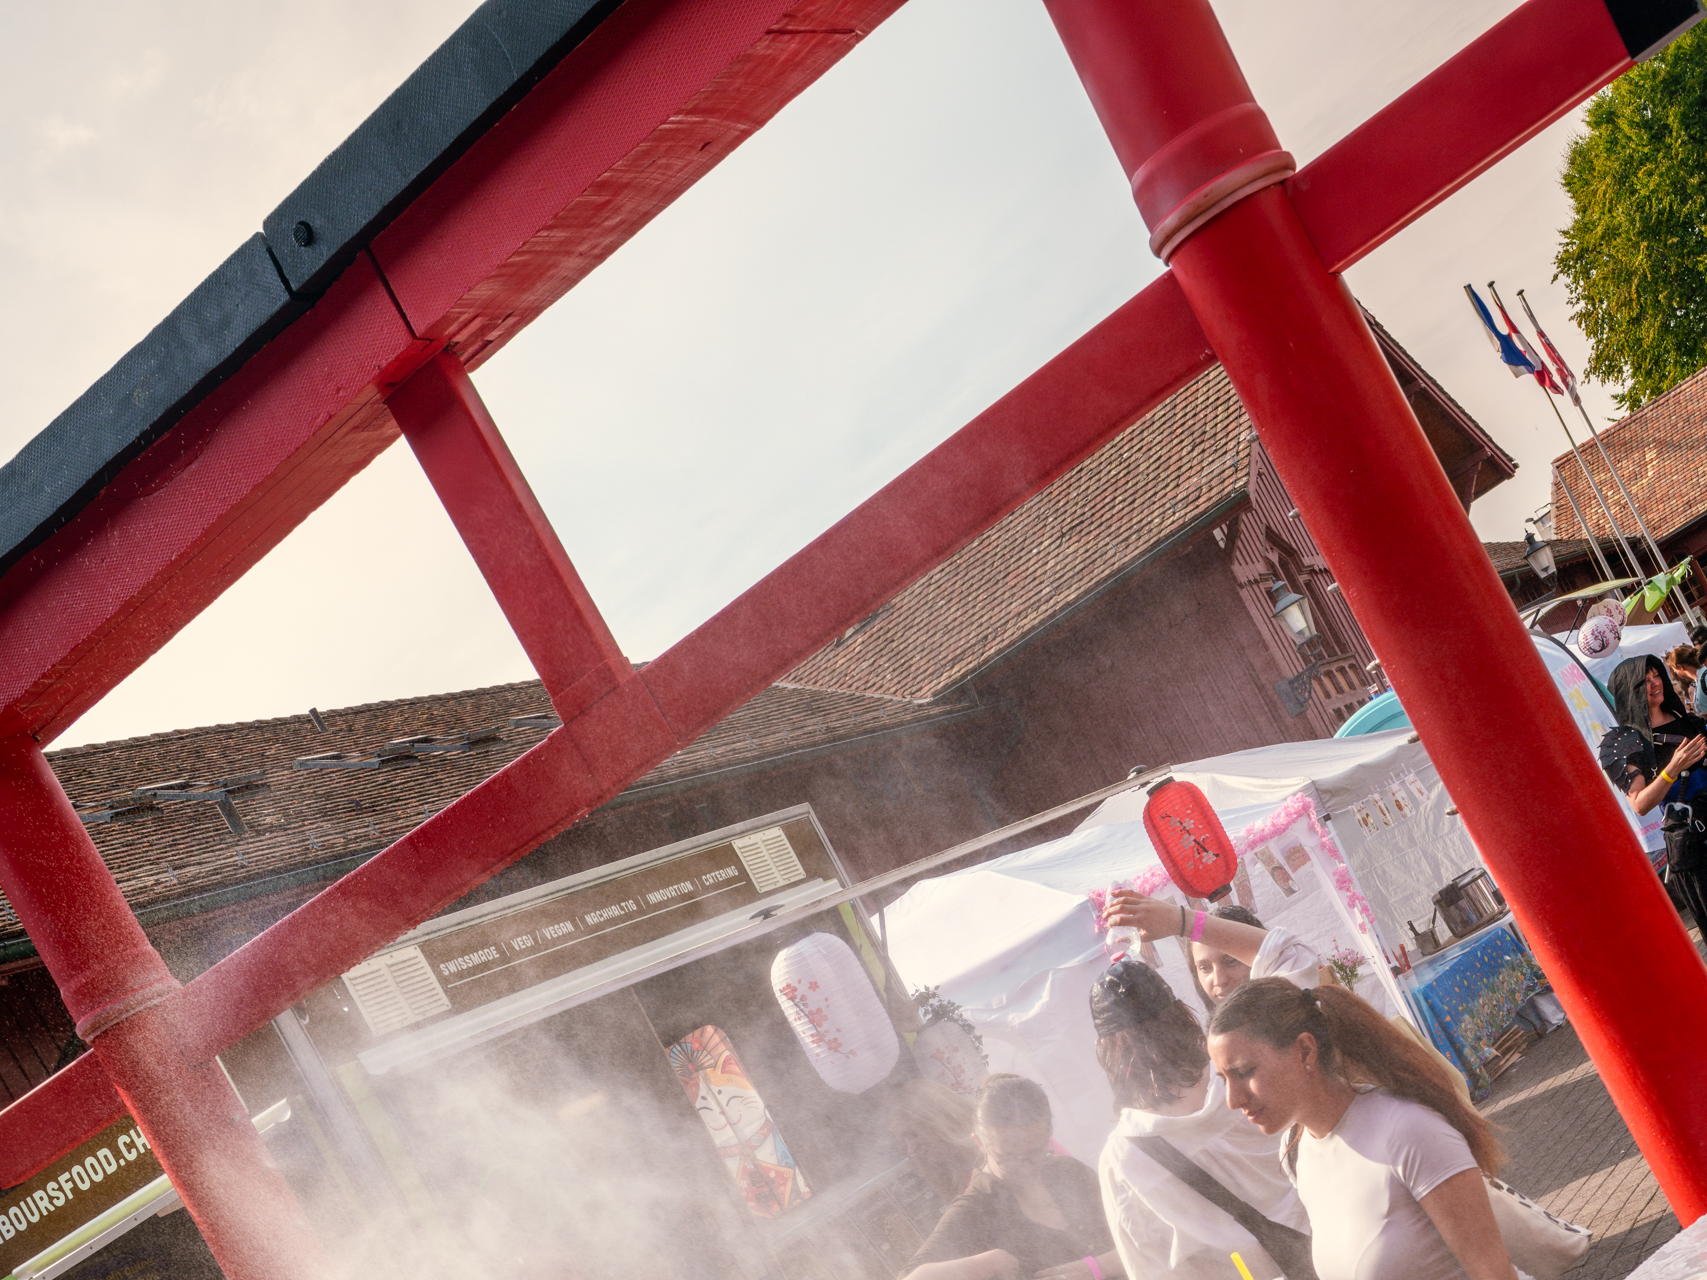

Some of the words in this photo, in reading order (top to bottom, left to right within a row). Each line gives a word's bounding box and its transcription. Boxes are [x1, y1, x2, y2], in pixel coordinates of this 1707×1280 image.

[440, 946, 500, 976] SWISSMADE
[510, 935, 535, 952] VEGI
[542, 920, 575, 941] VEGAN
[584, 899, 637, 926] NACHHALTIG
[646, 881, 694, 905] INNOVATION
[702, 865, 739, 887] CATERING
[0, 1125, 151, 1245] BOURSFOOD.CH
